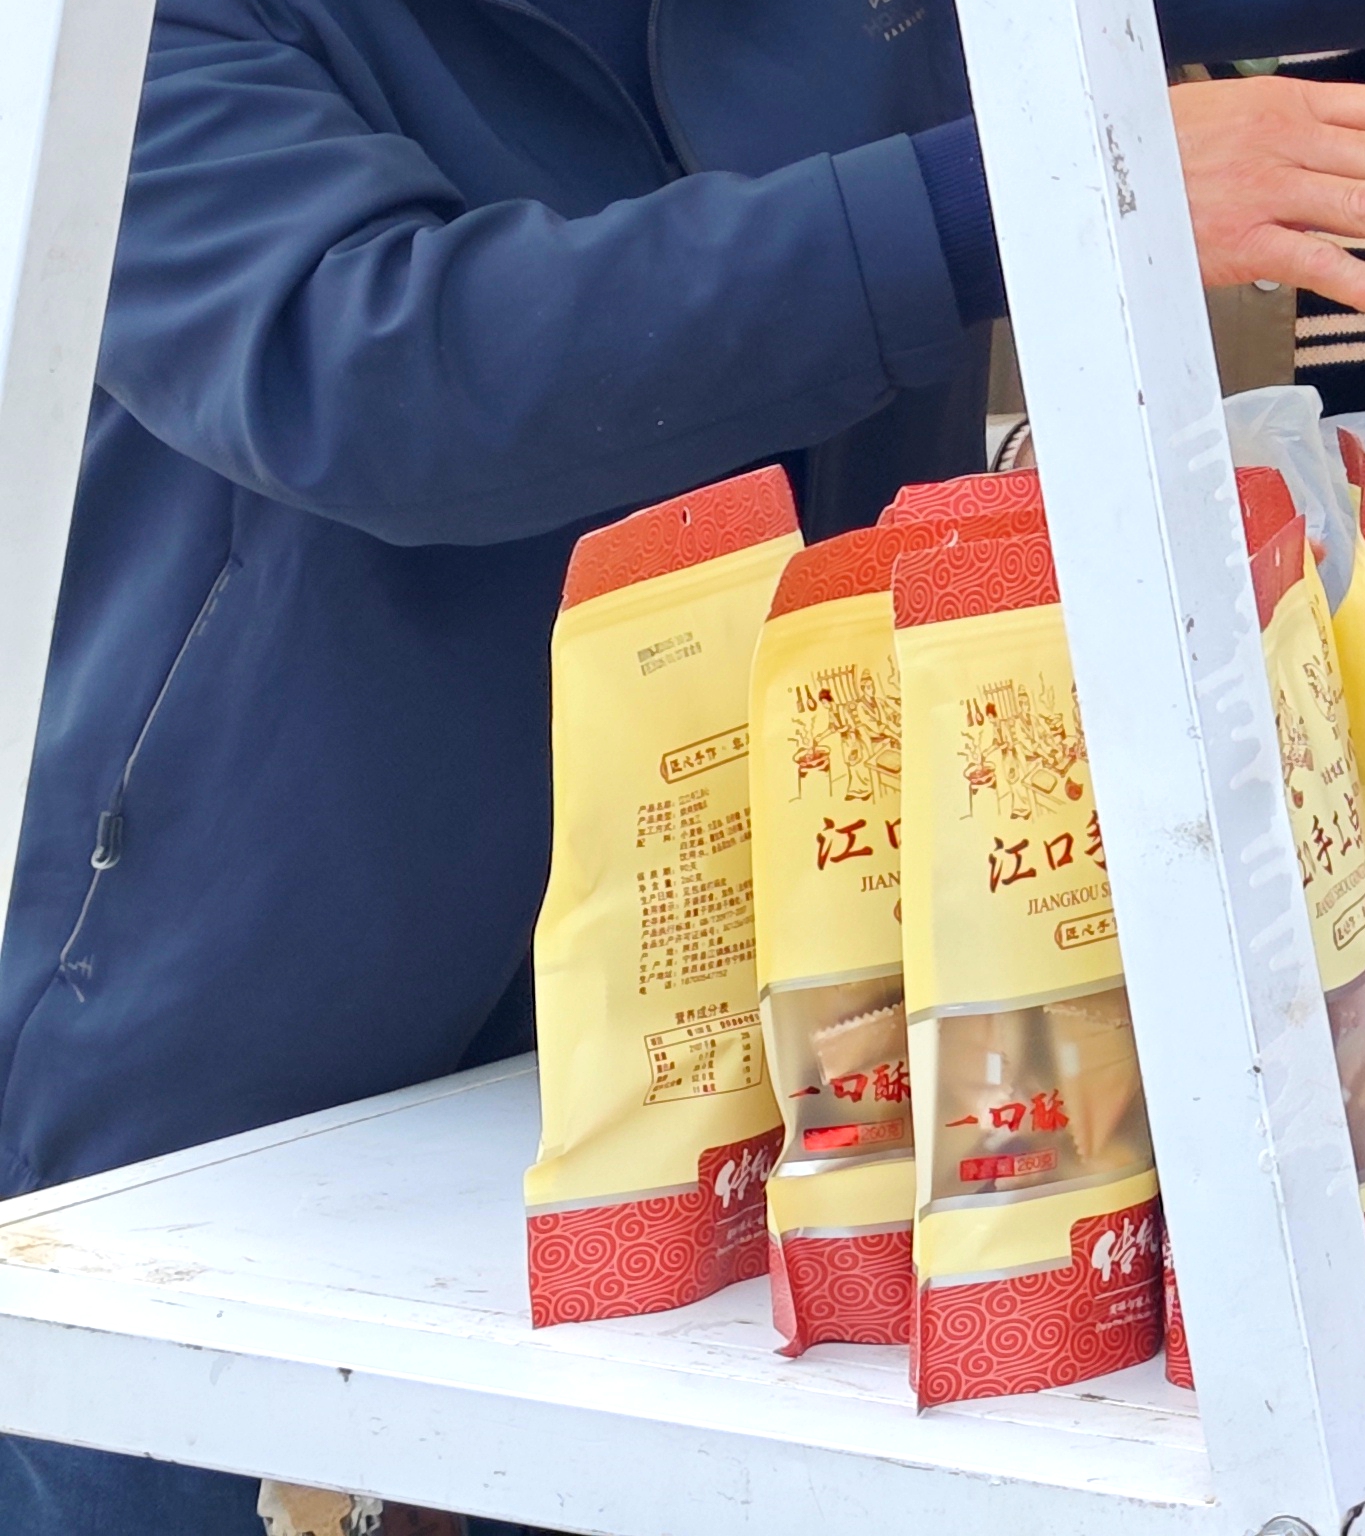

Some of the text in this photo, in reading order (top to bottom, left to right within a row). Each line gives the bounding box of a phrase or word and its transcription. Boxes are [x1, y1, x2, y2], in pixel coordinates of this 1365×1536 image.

[1027, 883, 1099, 916] JIANGKOU
[788, 1061, 912, 1104] 一口酥
[945, 1089, 1069, 1133] 一口酥
